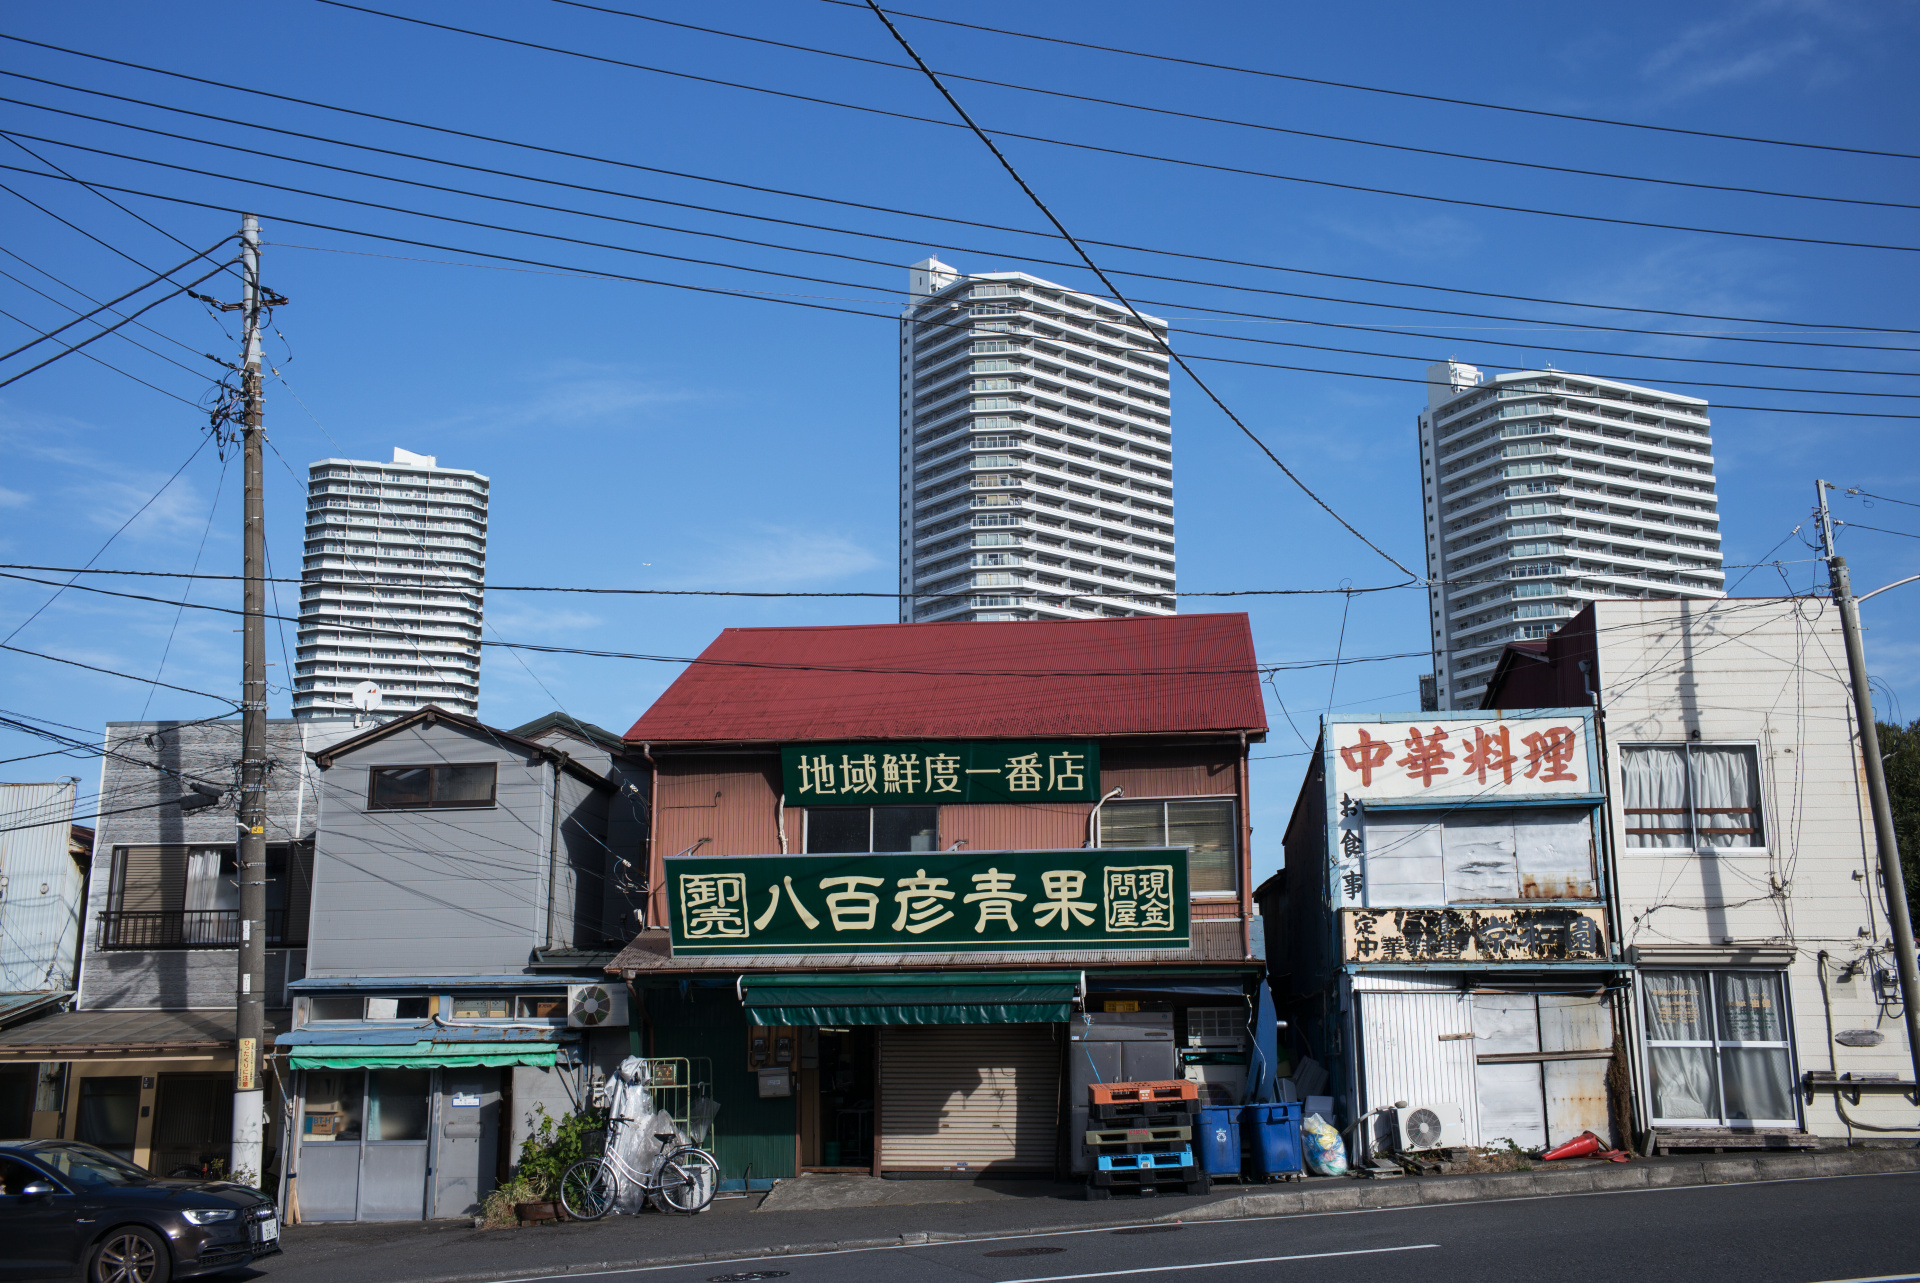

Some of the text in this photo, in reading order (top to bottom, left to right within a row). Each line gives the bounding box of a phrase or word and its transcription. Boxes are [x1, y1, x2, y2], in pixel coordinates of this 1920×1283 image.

[797, 750, 1085, 795] 地域鮮度一番店
[1340, 724, 1578, 788] 中華料理
[1339, 792, 1363, 901] お食事
[685, 877, 743, 934] 卸売
[753, 867, 1098, 935] 八百彦青果
